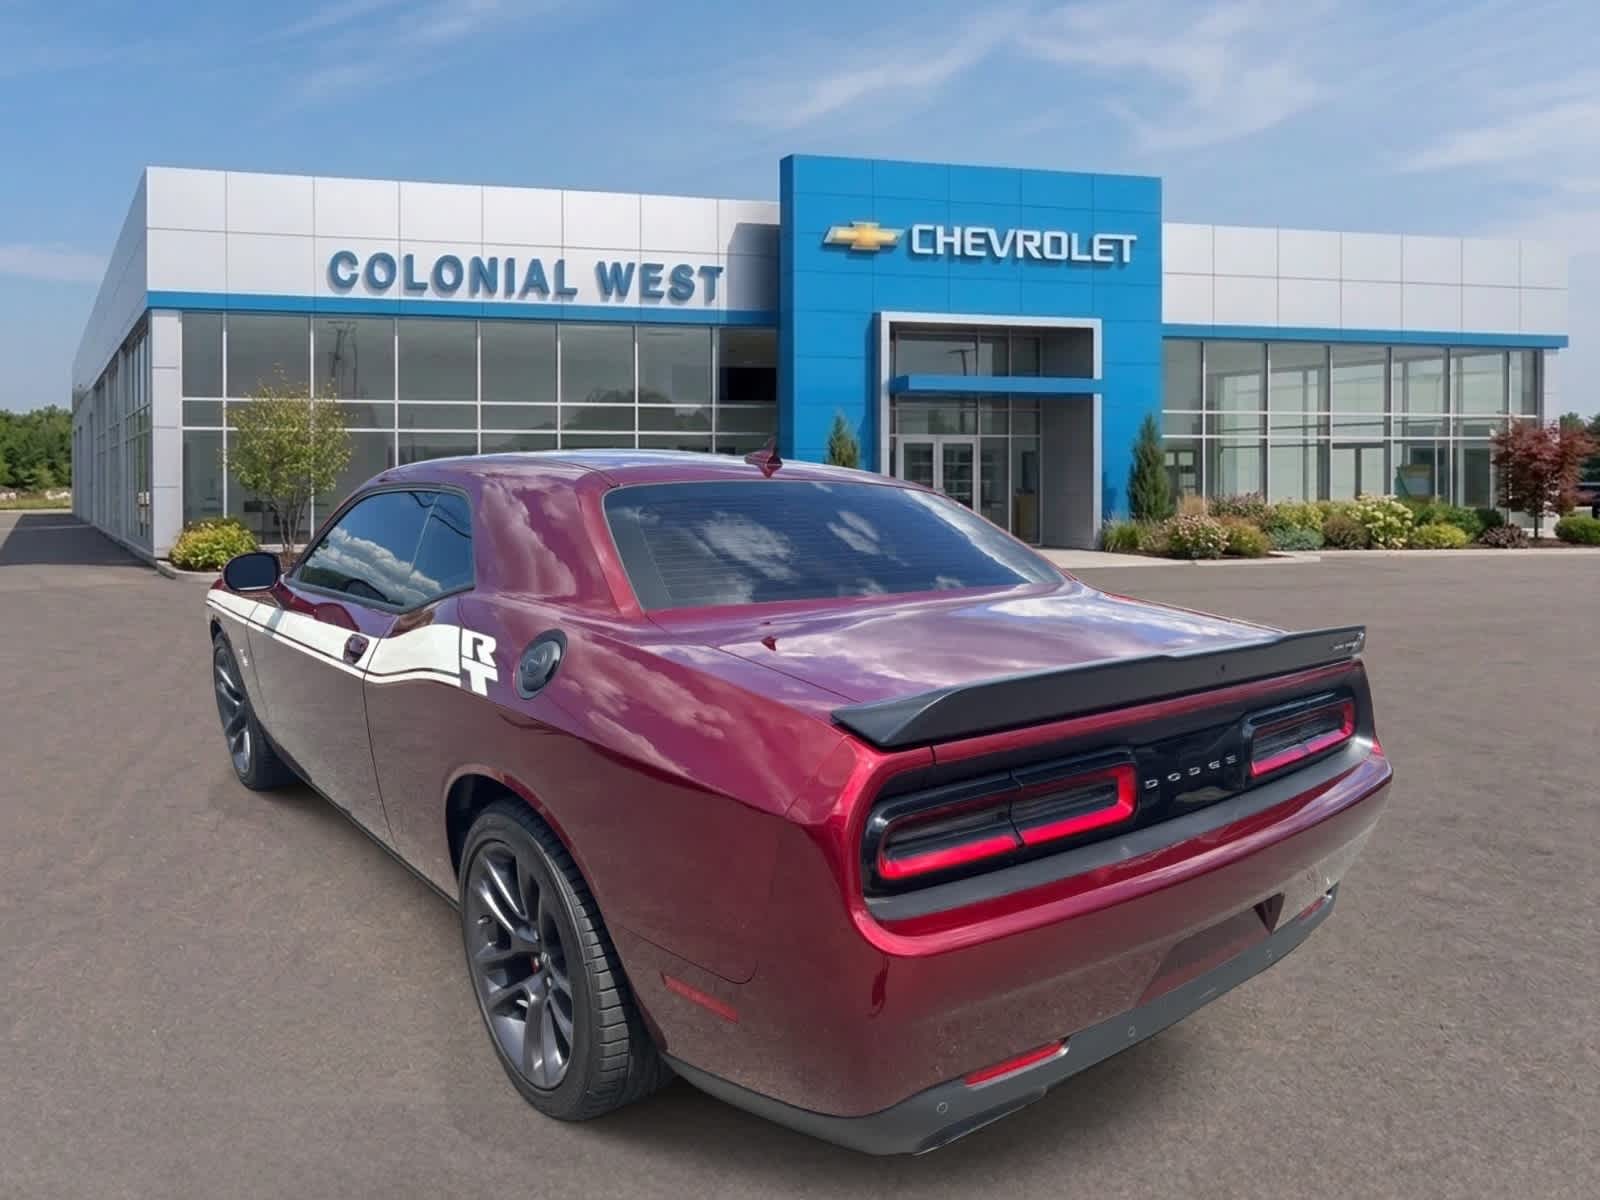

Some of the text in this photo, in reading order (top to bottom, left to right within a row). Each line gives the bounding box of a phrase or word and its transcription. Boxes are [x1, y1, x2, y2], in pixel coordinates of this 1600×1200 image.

[911, 224, 1137, 263] CHEVROLET
[329, 250, 723, 302] COLONIAL WEST
[1145, 755, 1237, 789] DODGE
